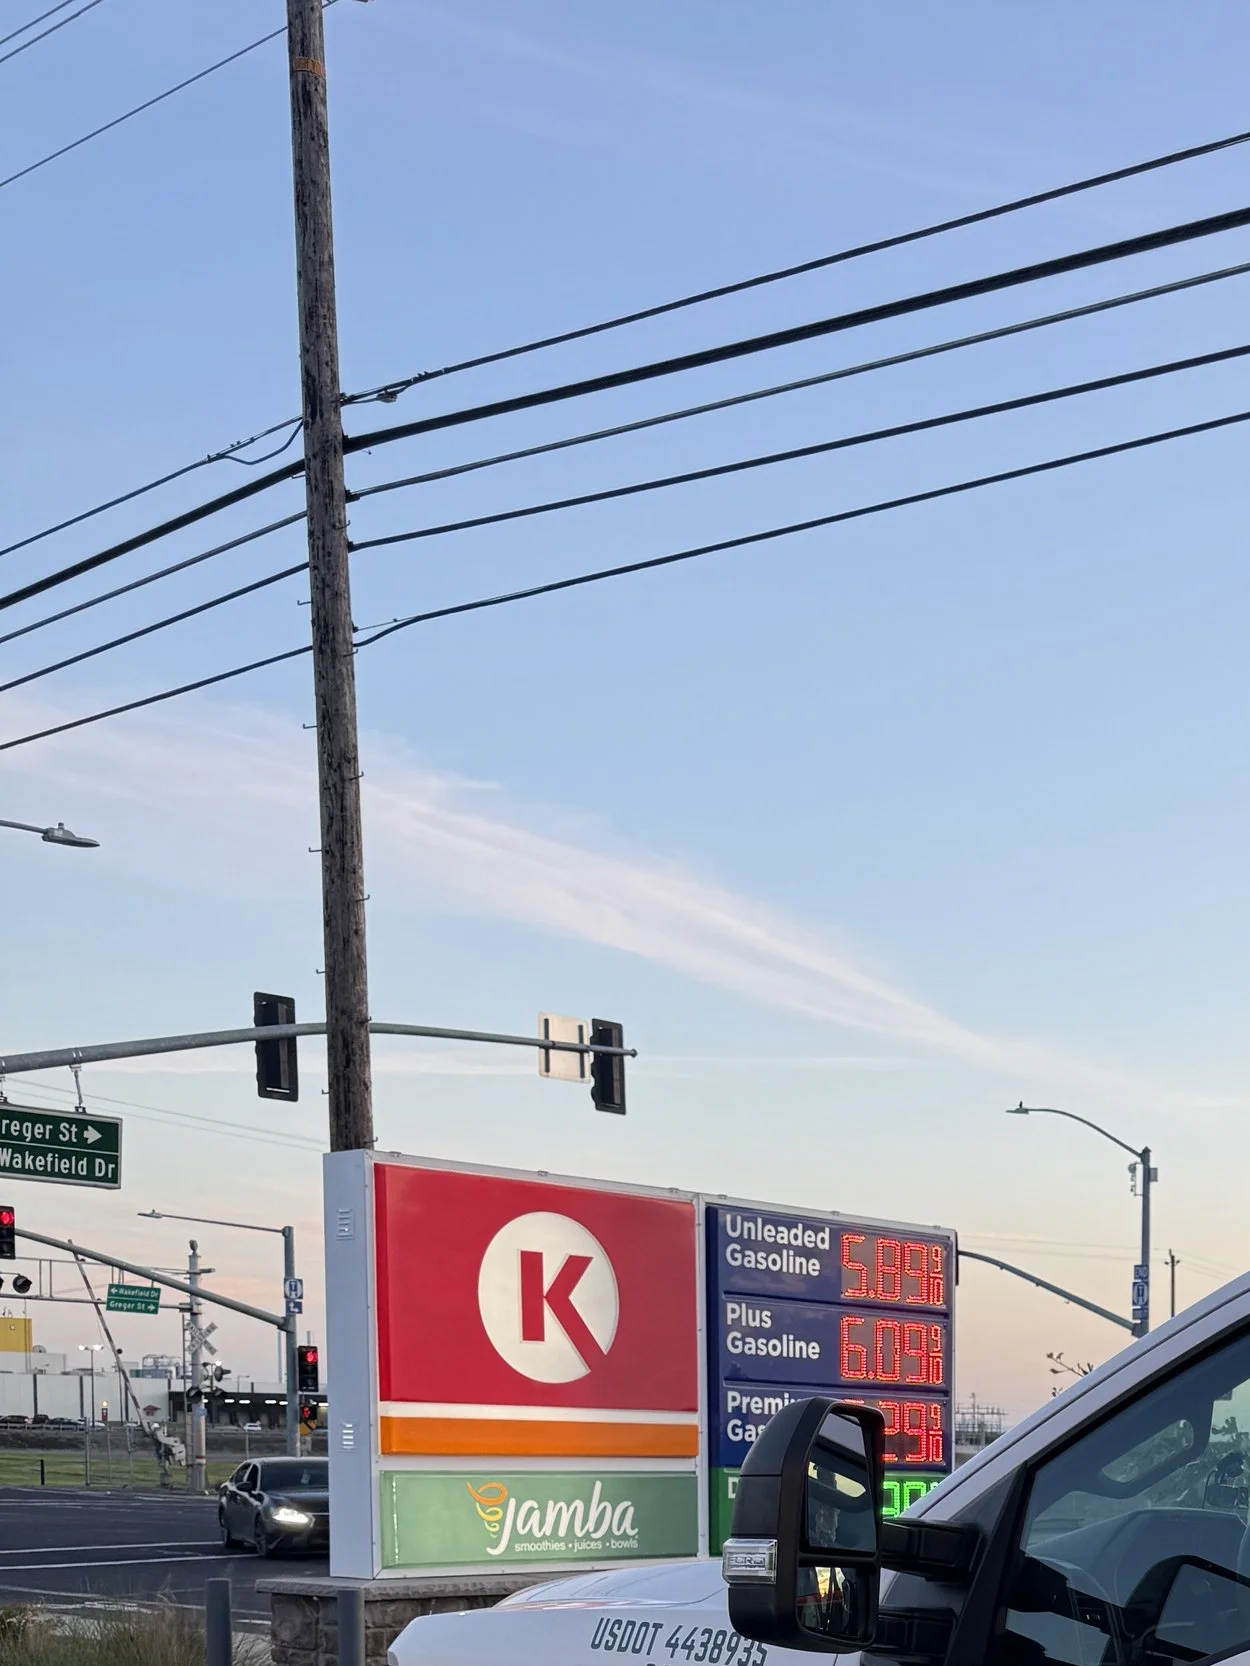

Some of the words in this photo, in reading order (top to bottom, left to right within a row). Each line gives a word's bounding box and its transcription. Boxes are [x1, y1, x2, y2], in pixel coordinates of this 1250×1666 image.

[1, 1119, 54, 1142] reger
[59, 1122, 78, 1143] St
[0, 1147, 88, 1176] Wakefield
[94, 1157, 116, 1179] Dr
[725, 1213, 830, 1251] Unleaded
[725, 1244, 821, 1277] Gasoline
[109, 1301, 135, 1311] Greger
[136, 1302, 146, 1311] St
[118, 1287, 150, 1298] Wakefield
[150, 1290, 159, 1298] Dr
[519, 1249, 606, 1371] K
[726, 1303, 773, 1329] Plus
[726, 1331, 821, 1360] Gasoline
[727, 1391, 797, 1416] Premi
[486, 1480, 639, 1556] jamba
[514, 1539, 566, 1553] smoothies
[573, 1538, 603, 1553] juices
[610, 1537, 639, 1549] bowls
[590, 1617, 664, 1656] USDOT
